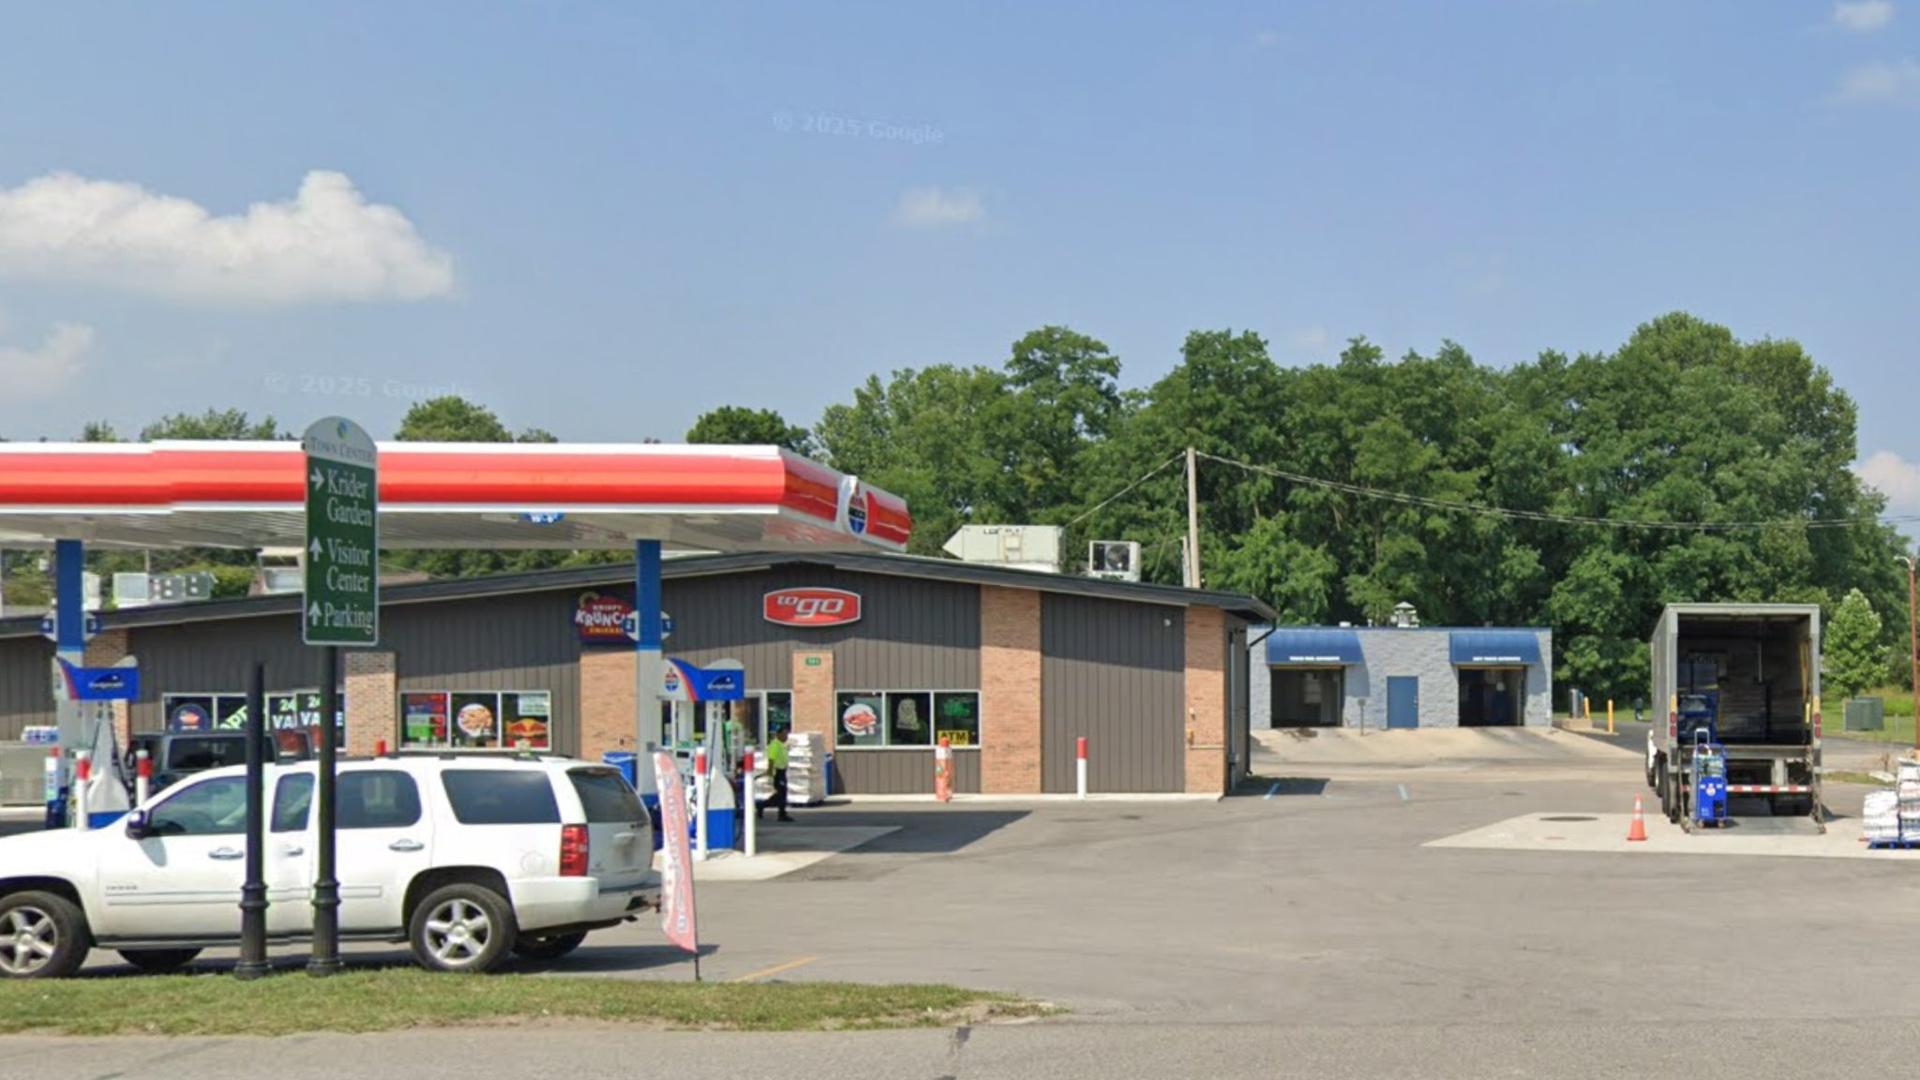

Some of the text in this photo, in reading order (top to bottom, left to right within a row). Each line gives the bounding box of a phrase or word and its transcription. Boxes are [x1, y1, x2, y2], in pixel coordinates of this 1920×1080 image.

[327, 468, 368, 499] Krider
[326, 496, 373, 527] Garden
[326, 538, 370, 566] Visitor
[326, 565, 370, 592] Center
[324, 602, 373, 635] Parking
[794, 598, 844, 618] go
